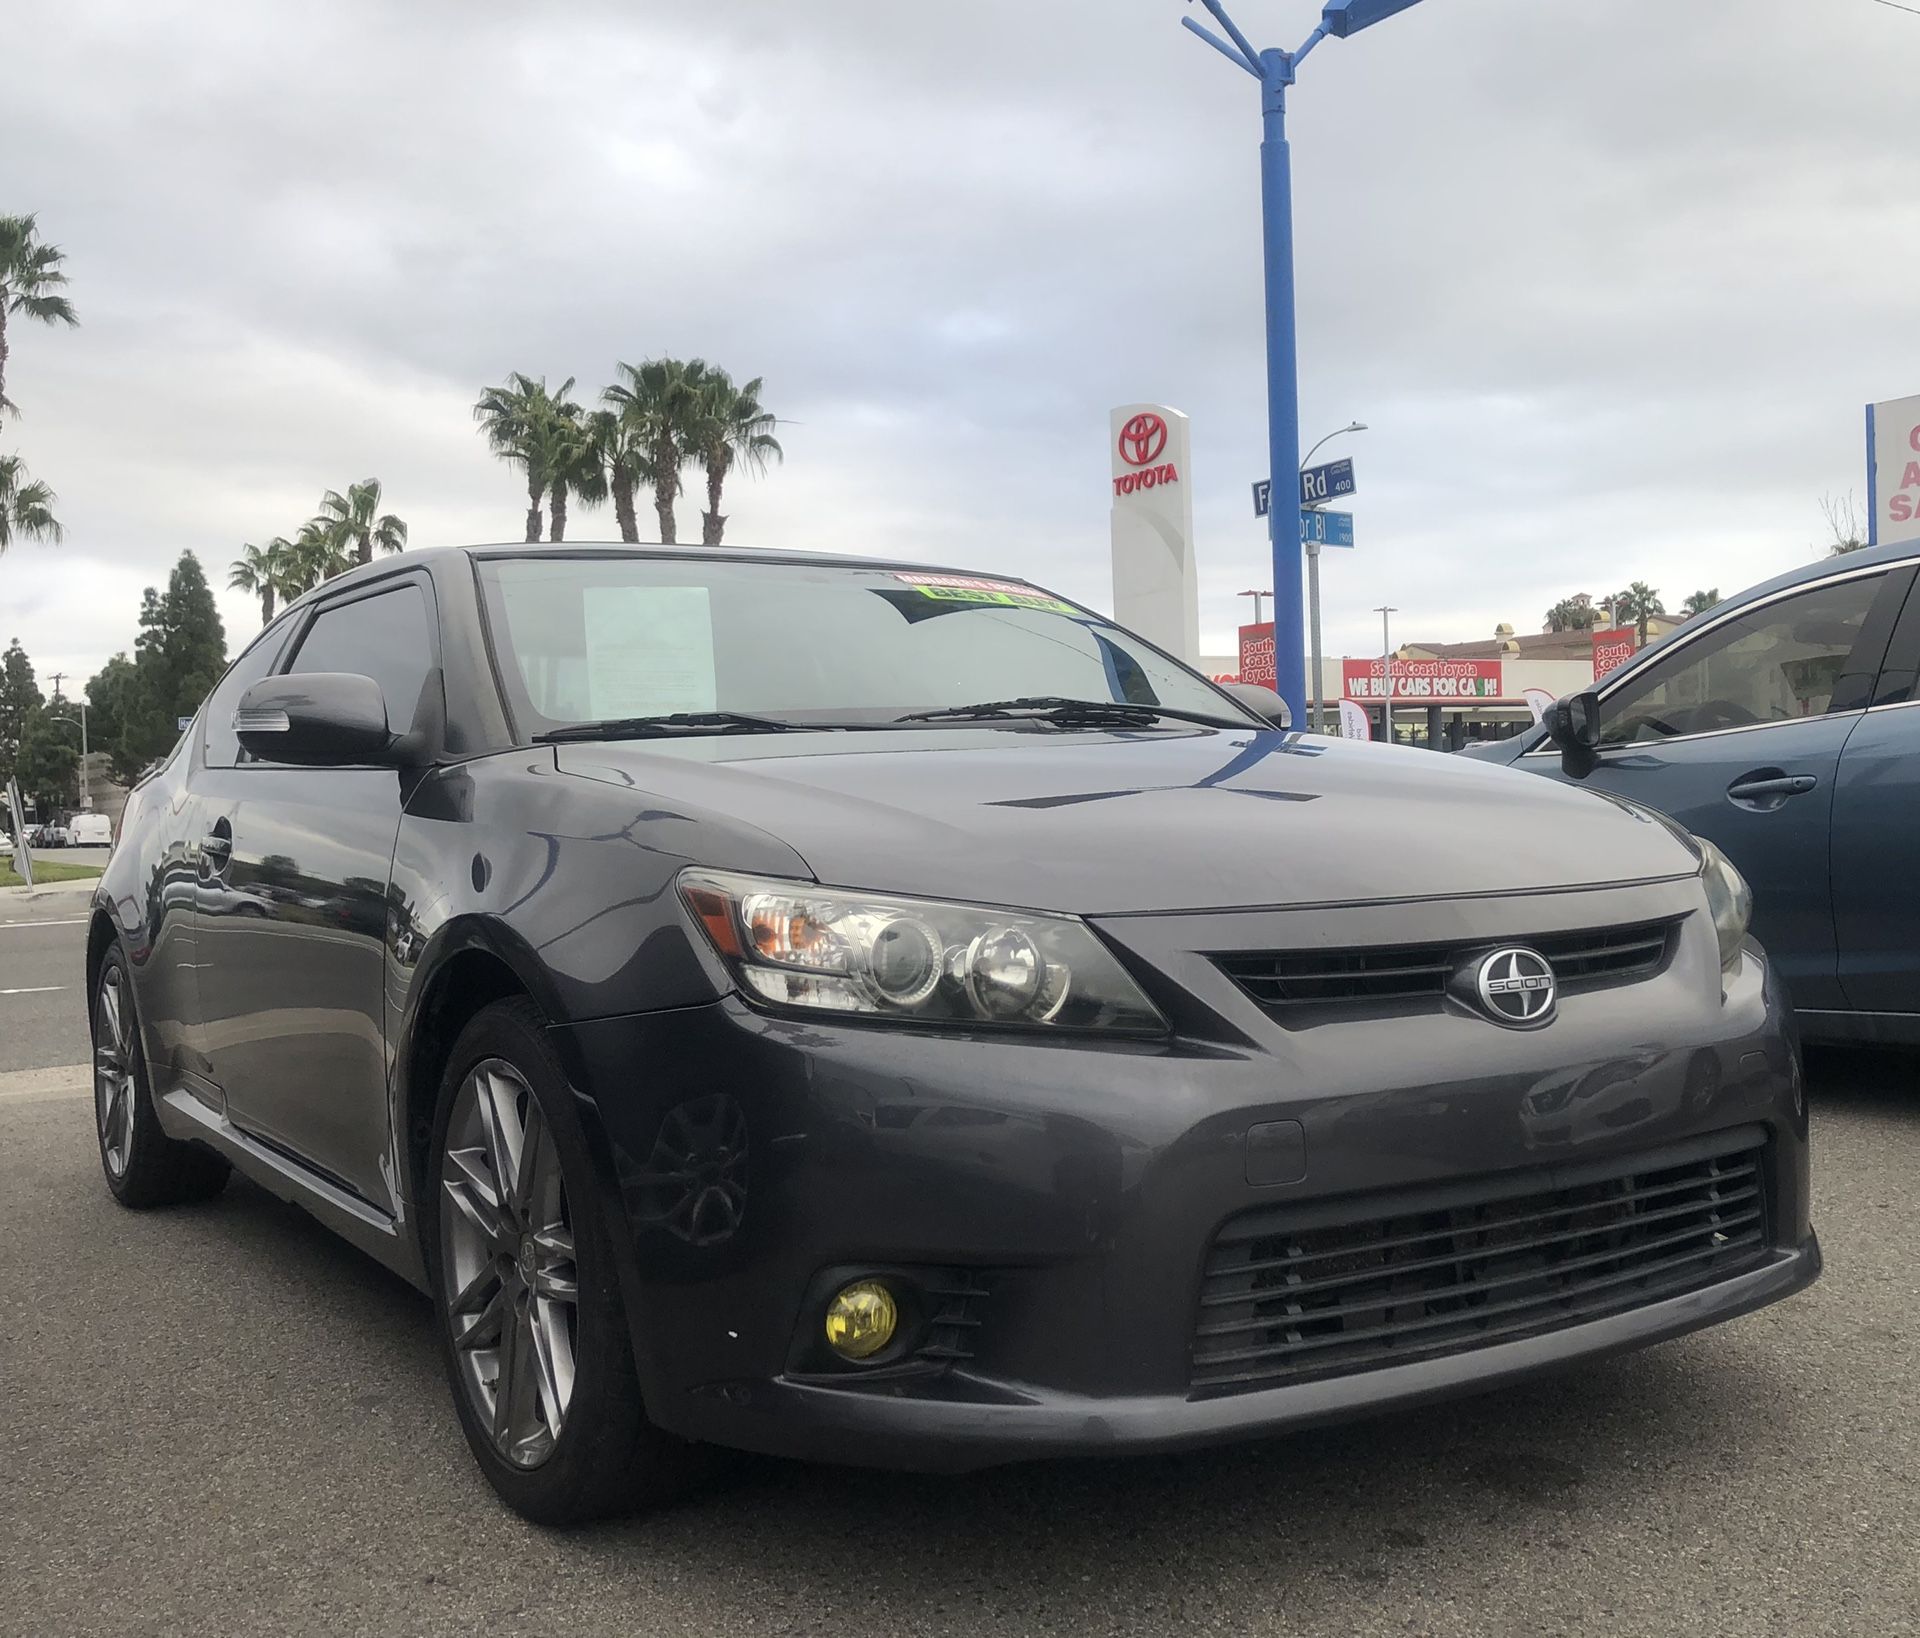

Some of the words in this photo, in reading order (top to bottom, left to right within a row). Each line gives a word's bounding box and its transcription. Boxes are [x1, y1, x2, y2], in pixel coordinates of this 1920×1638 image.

[1113, 463, 1178, 496] TOYOTA
[1303, 470, 1327, 500] Rd
[1335, 479, 1351, 491] 400
[1316, 513, 1326, 540] Bl
[927, 587, 1000, 602] BEST
[1006, 593, 1060, 609] BUY
[1243, 637, 1275, 655] South
[1597, 643, 1630, 658] South
[1243, 653, 1275, 668] Coast
[1241, 666, 1276, 684] Toyota
[1406, 661, 1439, 676] Coast
[1440, 661, 1477, 679] Toyota
[1348, 677, 1369, 696] WE
[1370, 677, 1396, 696] BUY
[1398, 677, 1431, 696] CARS
[1433, 678, 1457, 696] FOR
